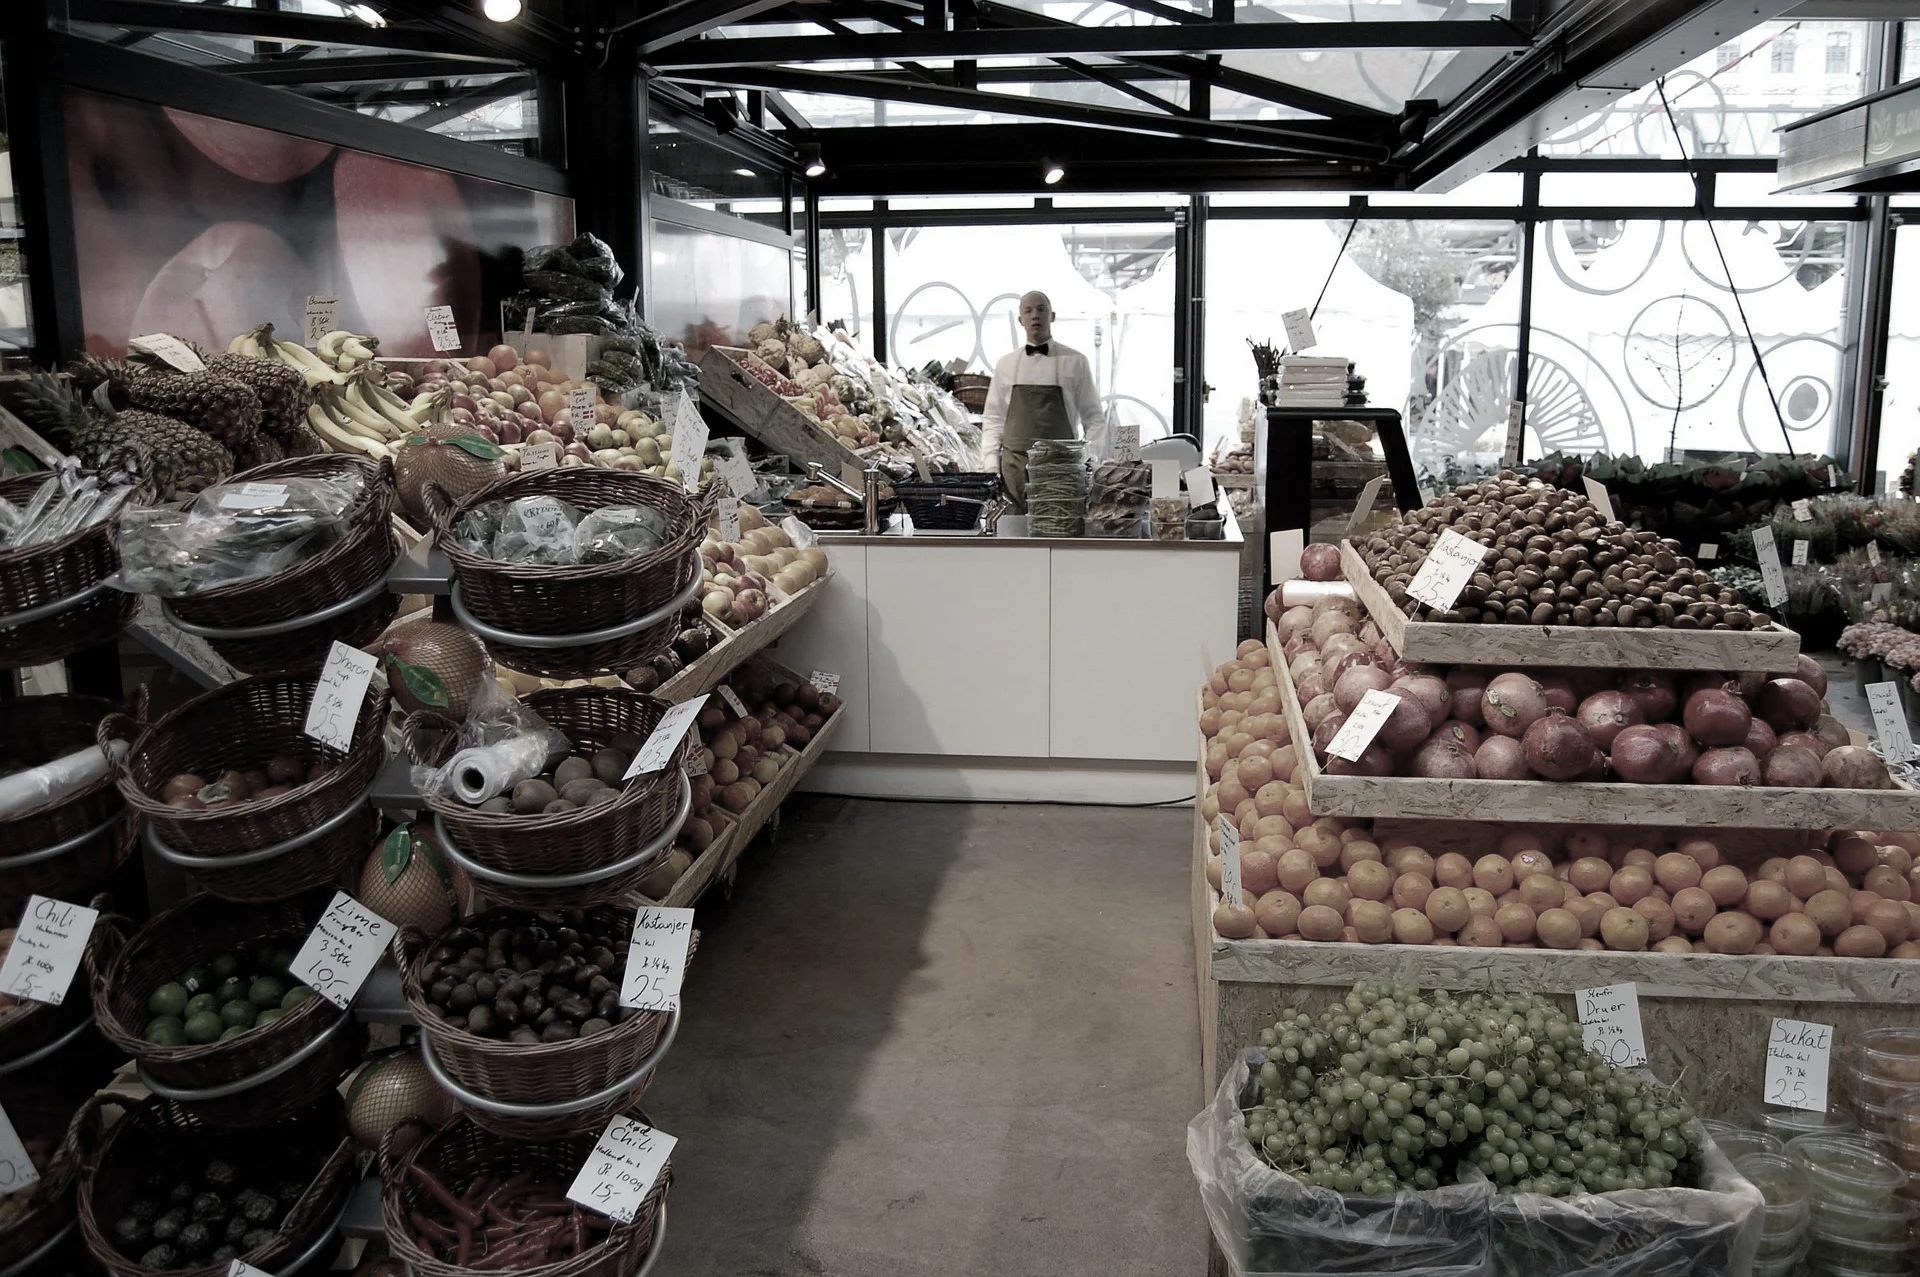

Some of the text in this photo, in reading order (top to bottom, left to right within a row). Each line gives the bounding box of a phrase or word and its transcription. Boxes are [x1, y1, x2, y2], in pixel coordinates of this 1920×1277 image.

[34, 899, 77, 928] Chili
[334, 897, 381, 937] Lime
[636, 908, 689, 935] Kastanjer
[1585, 999, 1627, 1017] Druer
[1771, 1019, 1828, 1050] Sukat
[610, 1126, 656, 1154] Chili
[625, 1119, 652, 1137] Rød
